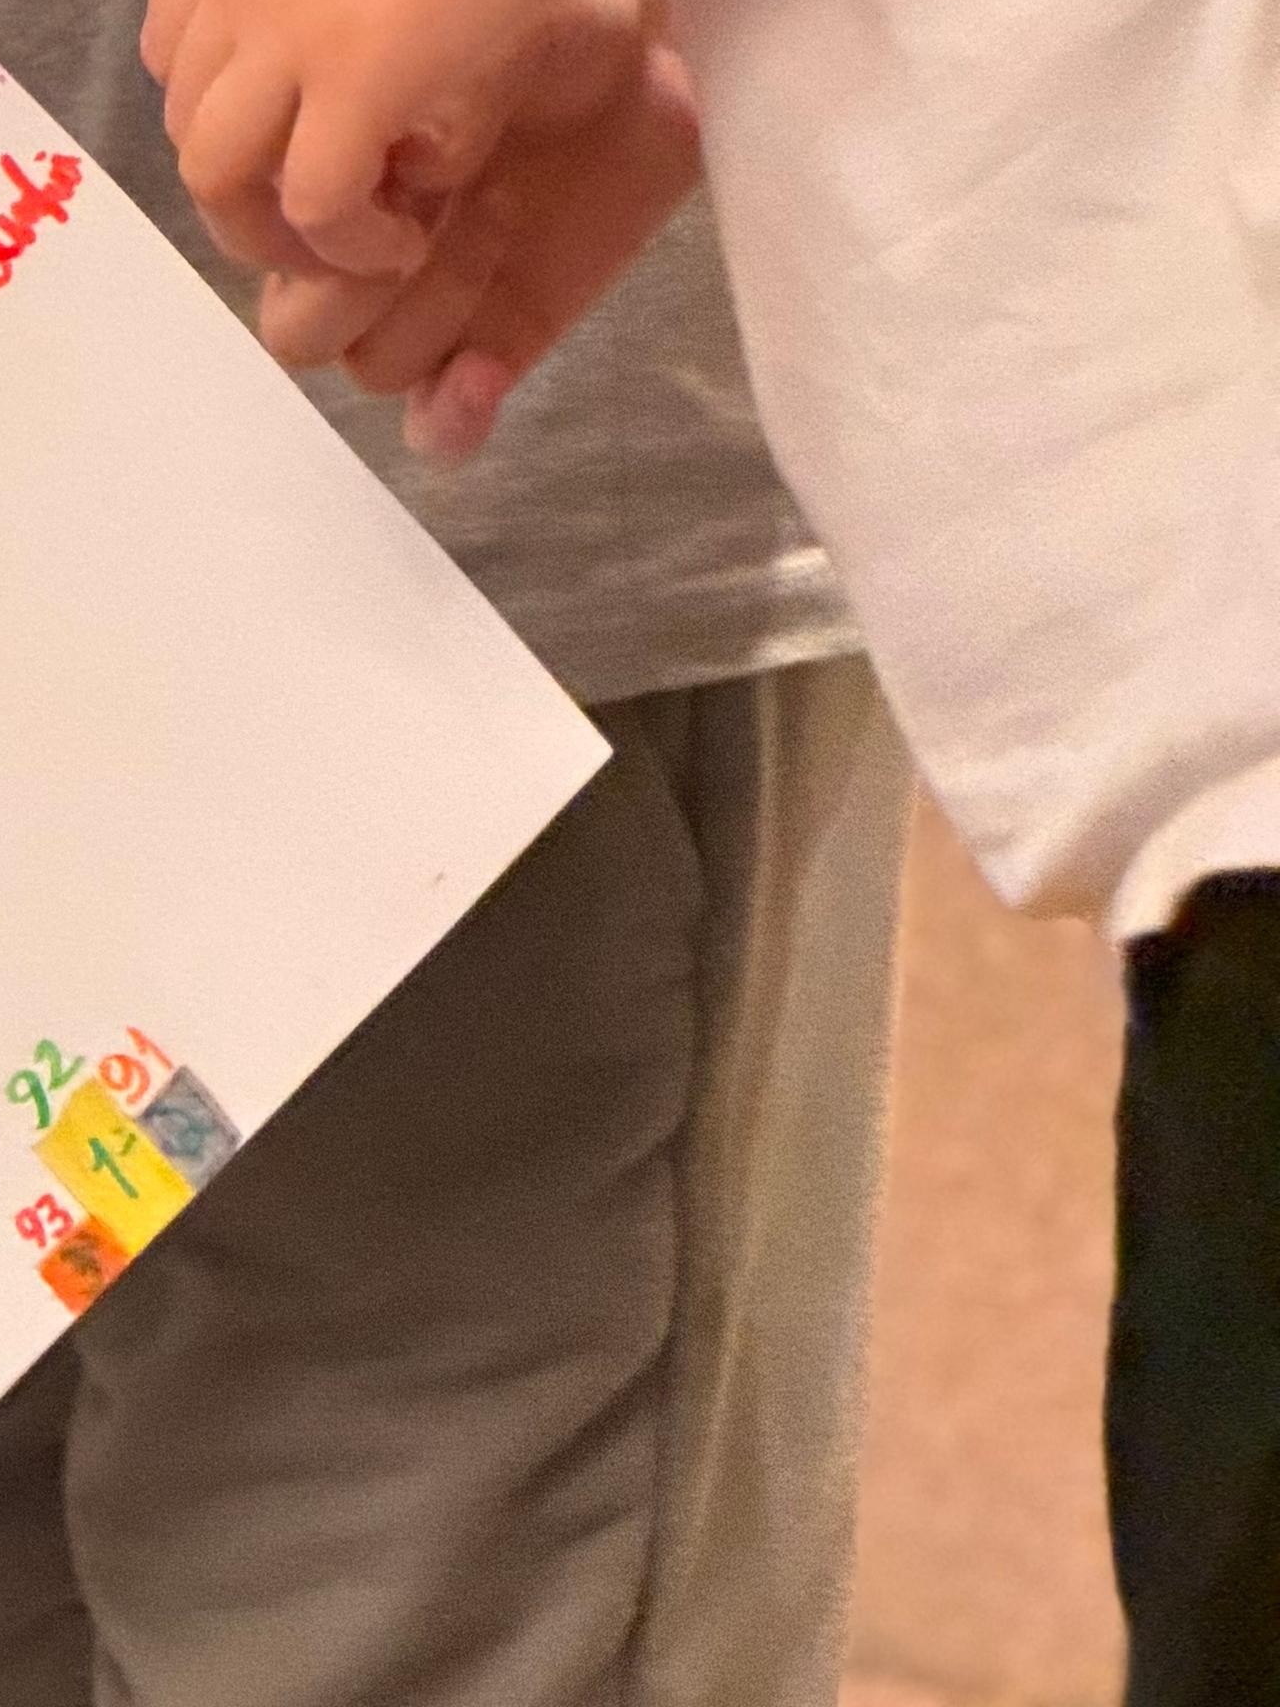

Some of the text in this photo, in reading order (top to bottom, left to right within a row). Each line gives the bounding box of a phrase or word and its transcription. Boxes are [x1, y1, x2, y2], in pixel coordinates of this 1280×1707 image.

[4, 1038, 87, 1129] 92
[97, 1024, 175, 1106] 91
[14, 1193, 75, 1248] 93
